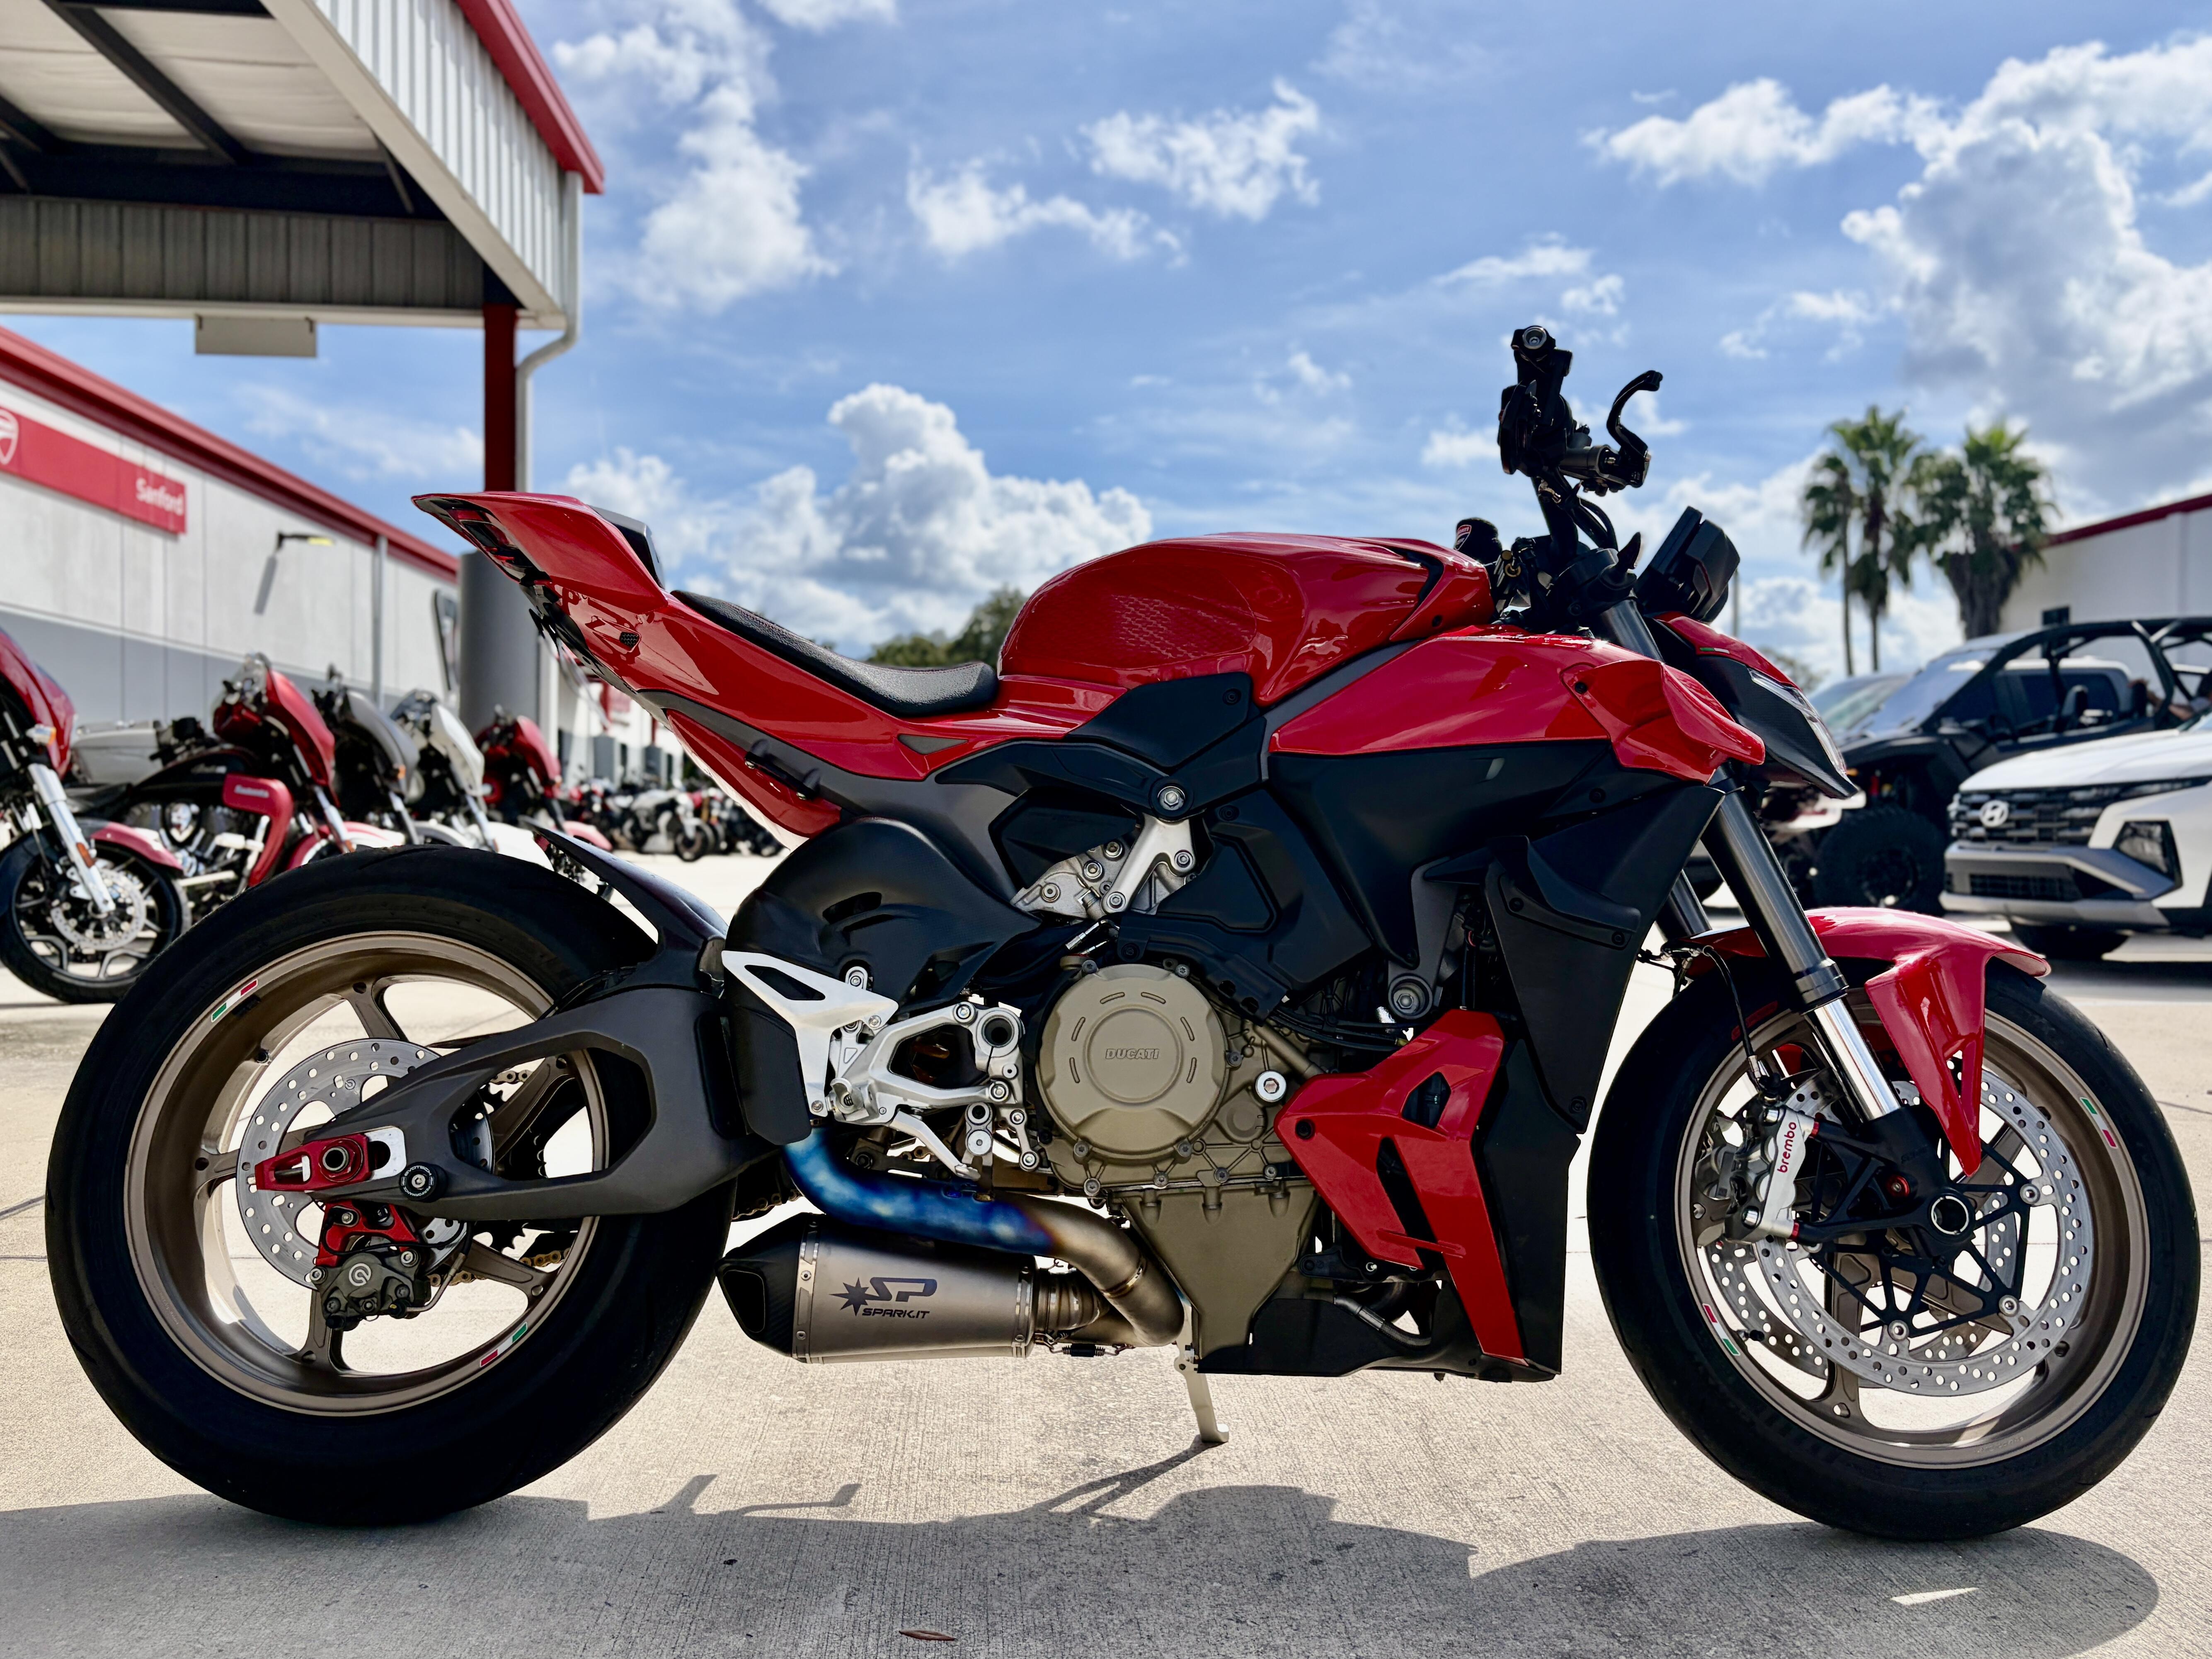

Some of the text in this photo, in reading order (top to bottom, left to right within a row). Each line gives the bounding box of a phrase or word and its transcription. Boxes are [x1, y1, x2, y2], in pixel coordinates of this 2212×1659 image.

[136, 477, 183, 516] Sanford
[1105, 1048, 1160, 1059] DUCATI
[1777, 1122, 1797, 1173] brembo
[870, 1277, 938, 1302] SP
[862, 1308, 930, 1319] SPARK.IT
